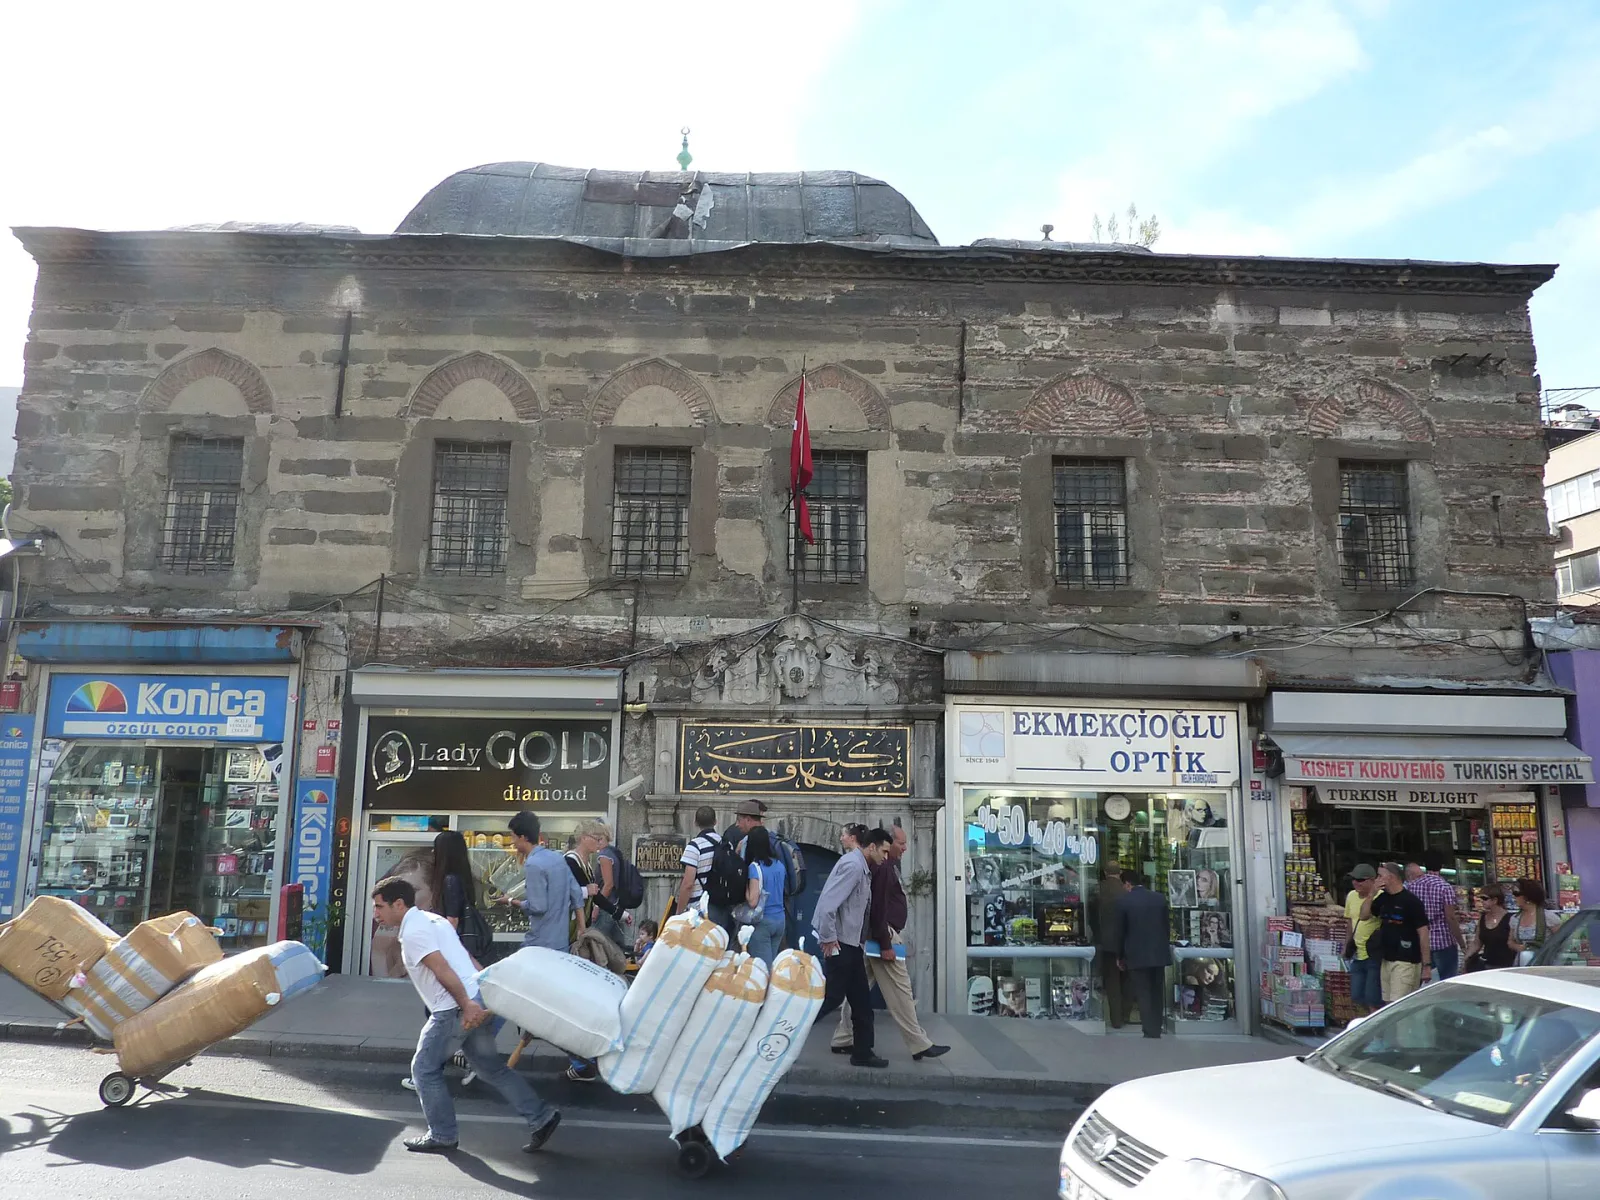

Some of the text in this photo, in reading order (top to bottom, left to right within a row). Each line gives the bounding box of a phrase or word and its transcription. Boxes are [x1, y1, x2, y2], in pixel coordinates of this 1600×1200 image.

[137, 682, 265, 717] Konica
[107, 722, 218, 736] ÖZGÜL COLOR
[1012, 708, 1227, 745] EKMEKÇİOĞLU
[419, 730, 608, 770] Lady GOLD
[1110, 744, 1207, 773] OPTİK
[539, 772, 552, 785] &
[1300, 759, 1584, 781] KISMET KURUYEMİŞ TURKISH SPECIAL
[502, 784, 588, 801] diamond
[1326, 788, 1479, 804] TURKISH DELIGHT
[336, 839, 348, 880] Lady
